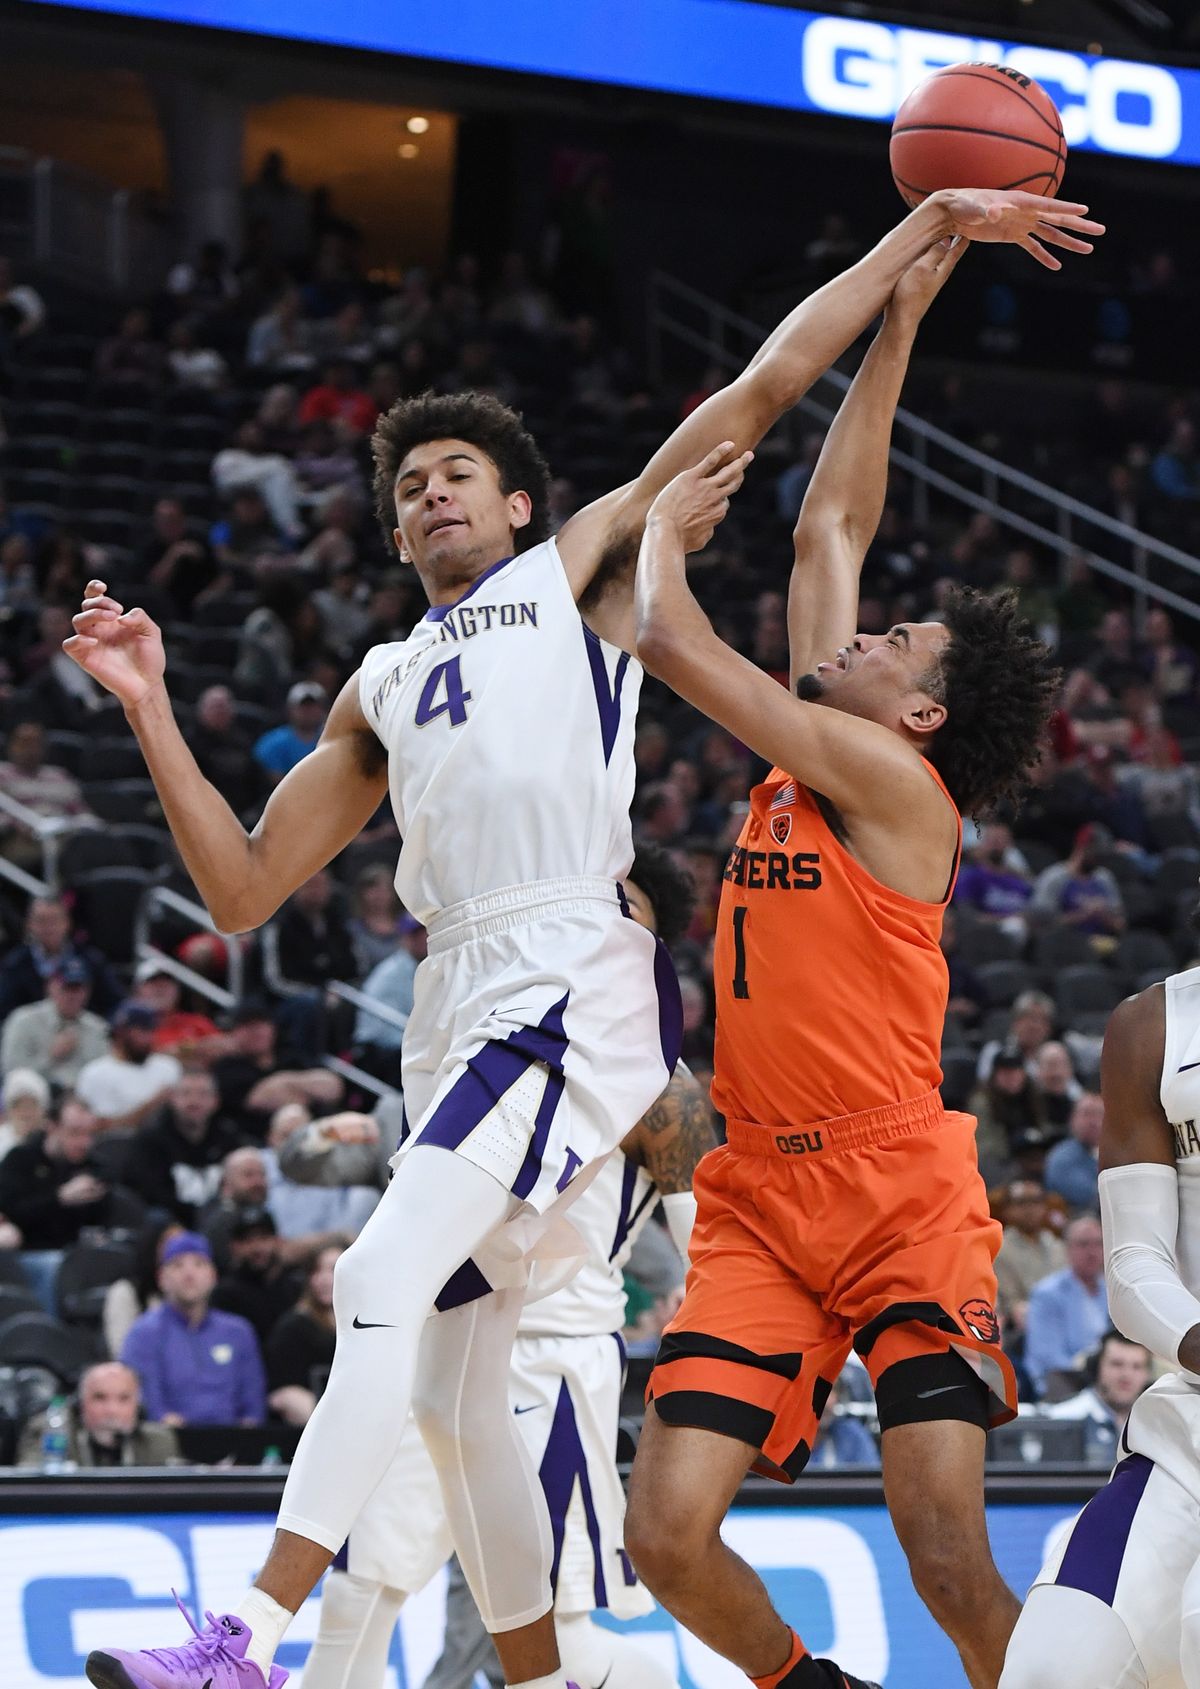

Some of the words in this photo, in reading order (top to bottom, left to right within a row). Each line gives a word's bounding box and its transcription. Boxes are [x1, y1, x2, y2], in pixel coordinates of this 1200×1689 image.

[802, 16, 1182, 159] GECO
[415, 653, 473, 729] 4
[732, 907, 750, 999] 1
[775, 1131, 823, 1154] OSU
